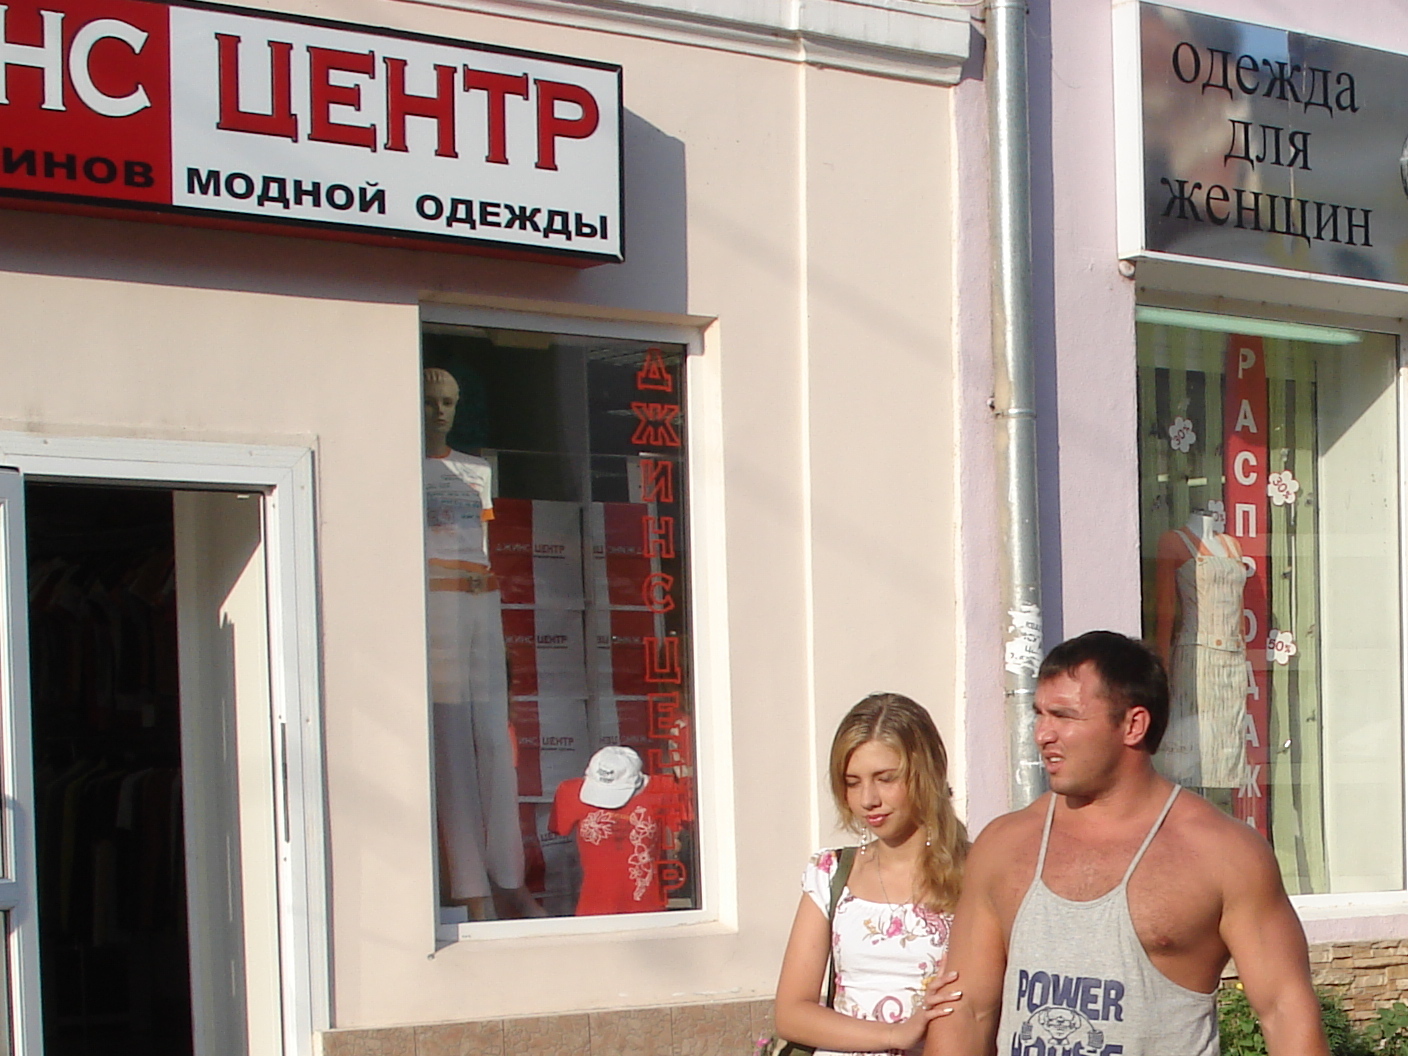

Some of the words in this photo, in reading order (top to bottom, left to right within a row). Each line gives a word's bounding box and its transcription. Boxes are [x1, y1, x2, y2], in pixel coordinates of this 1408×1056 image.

[215, 33, 600, 171] ЦЕНТР
[1172, 41, 1360, 115] одежда
[1225, 118, 1312, 172] для
[187, 168, 387, 214] МОДНОЙ
[416, 194, 608, 241] ОДЕЖДЫ
[1160, 173, 1373, 248] женщин
[631, 347, 681, 614] ДЖИНС
[1016, 969, 1125, 1022] POWER
